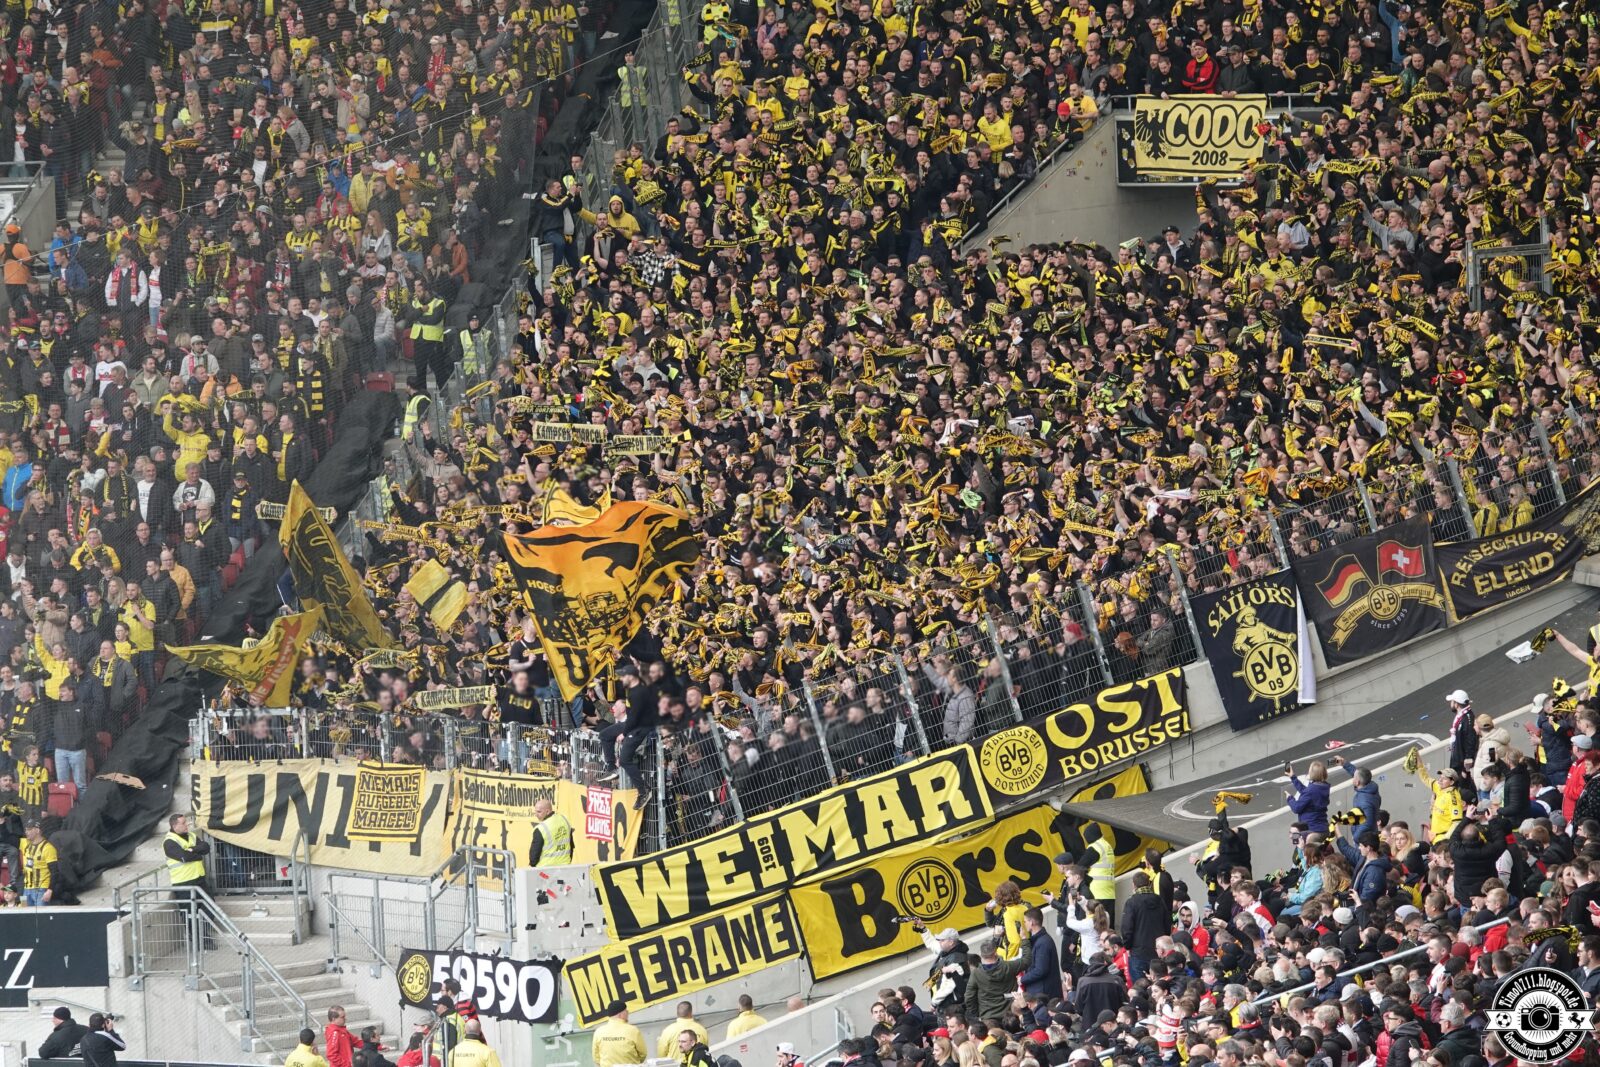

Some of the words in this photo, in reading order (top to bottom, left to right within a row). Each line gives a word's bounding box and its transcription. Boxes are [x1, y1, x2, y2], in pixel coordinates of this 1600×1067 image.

[1191, 150, 1228, 166] 2008
[1473, 551, 1555, 597] ELEND
[1208, 586, 1296, 638] SAILORS
[1372, 589, 1397, 611] BVB
[1250, 646, 1293, 685] BVB
[1268, 677, 1285, 692] 09
[1046, 667, 1182, 749] OST
[1258, 703, 1297, 721] HAMBU
[999, 742, 1031, 772] BVB
[1012, 766, 1023, 777] 09
[463, 777, 496, 805] Sektion
[994, 763, 1045, 792] DORTMUND
[588, 790, 611, 816] FREE
[613, 760, 973, 929] WEIMAR
[757, 836, 777, 872] 1909
[907, 868, 950, 908] BVB
[925, 900, 941, 914] 09
[571, 904, 790, 1018] MEERANE
[431, 954, 555, 1020] 59590
